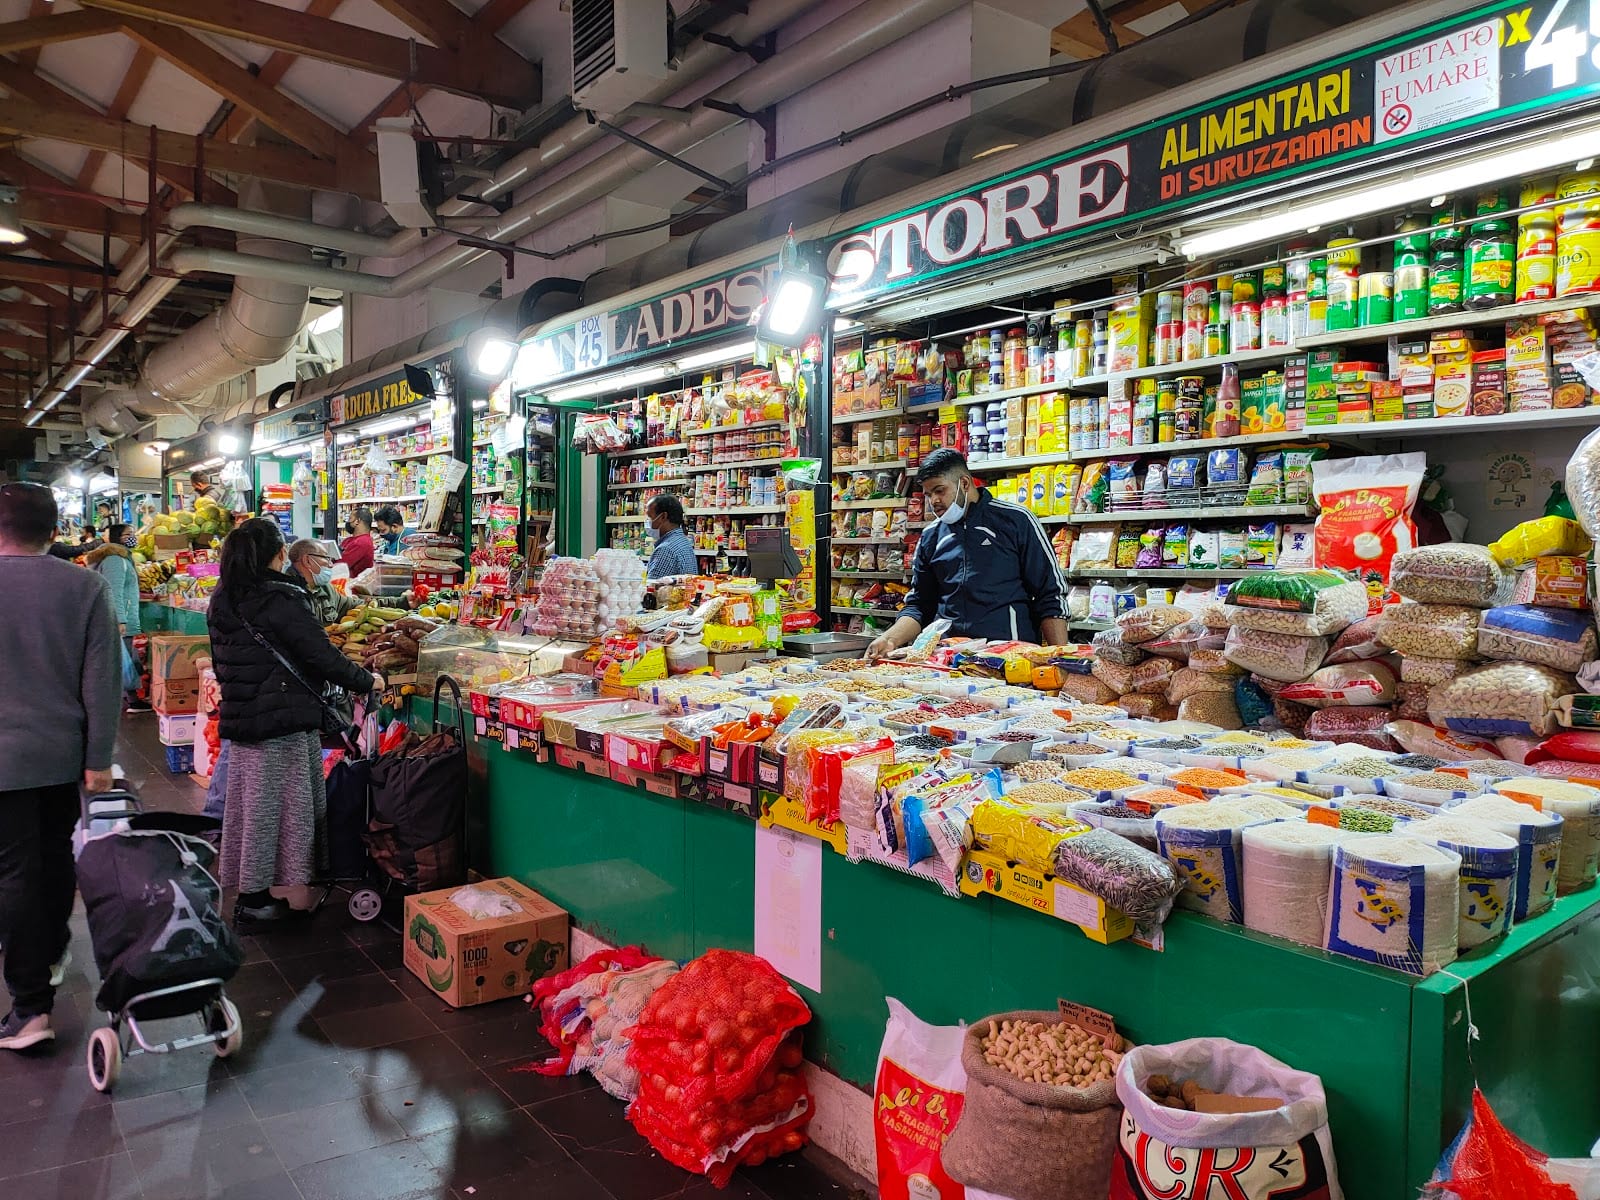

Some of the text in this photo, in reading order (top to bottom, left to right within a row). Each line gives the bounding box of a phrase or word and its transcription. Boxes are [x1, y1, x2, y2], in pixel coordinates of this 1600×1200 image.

[1381, 25, 1494, 78] VIETATO
[1525, 0, 1600, 89] 4
[1380, 56, 1489, 108] FUMARE
[1159, 68, 1351, 170] ALIMENTARI
[1160, 115, 1371, 201] DI SURUZZAMAN
[826, 142, 1130, 292] STORE
[581, 316, 600, 332] BOX
[579, 332, 602, 367] 45
[1243, 379, 1265, 390] BEST
[1266, 376, 1285, 386] BEST
[462, 947, 488, 964] 1000
[878, 1087, 925, 1120] Ali
